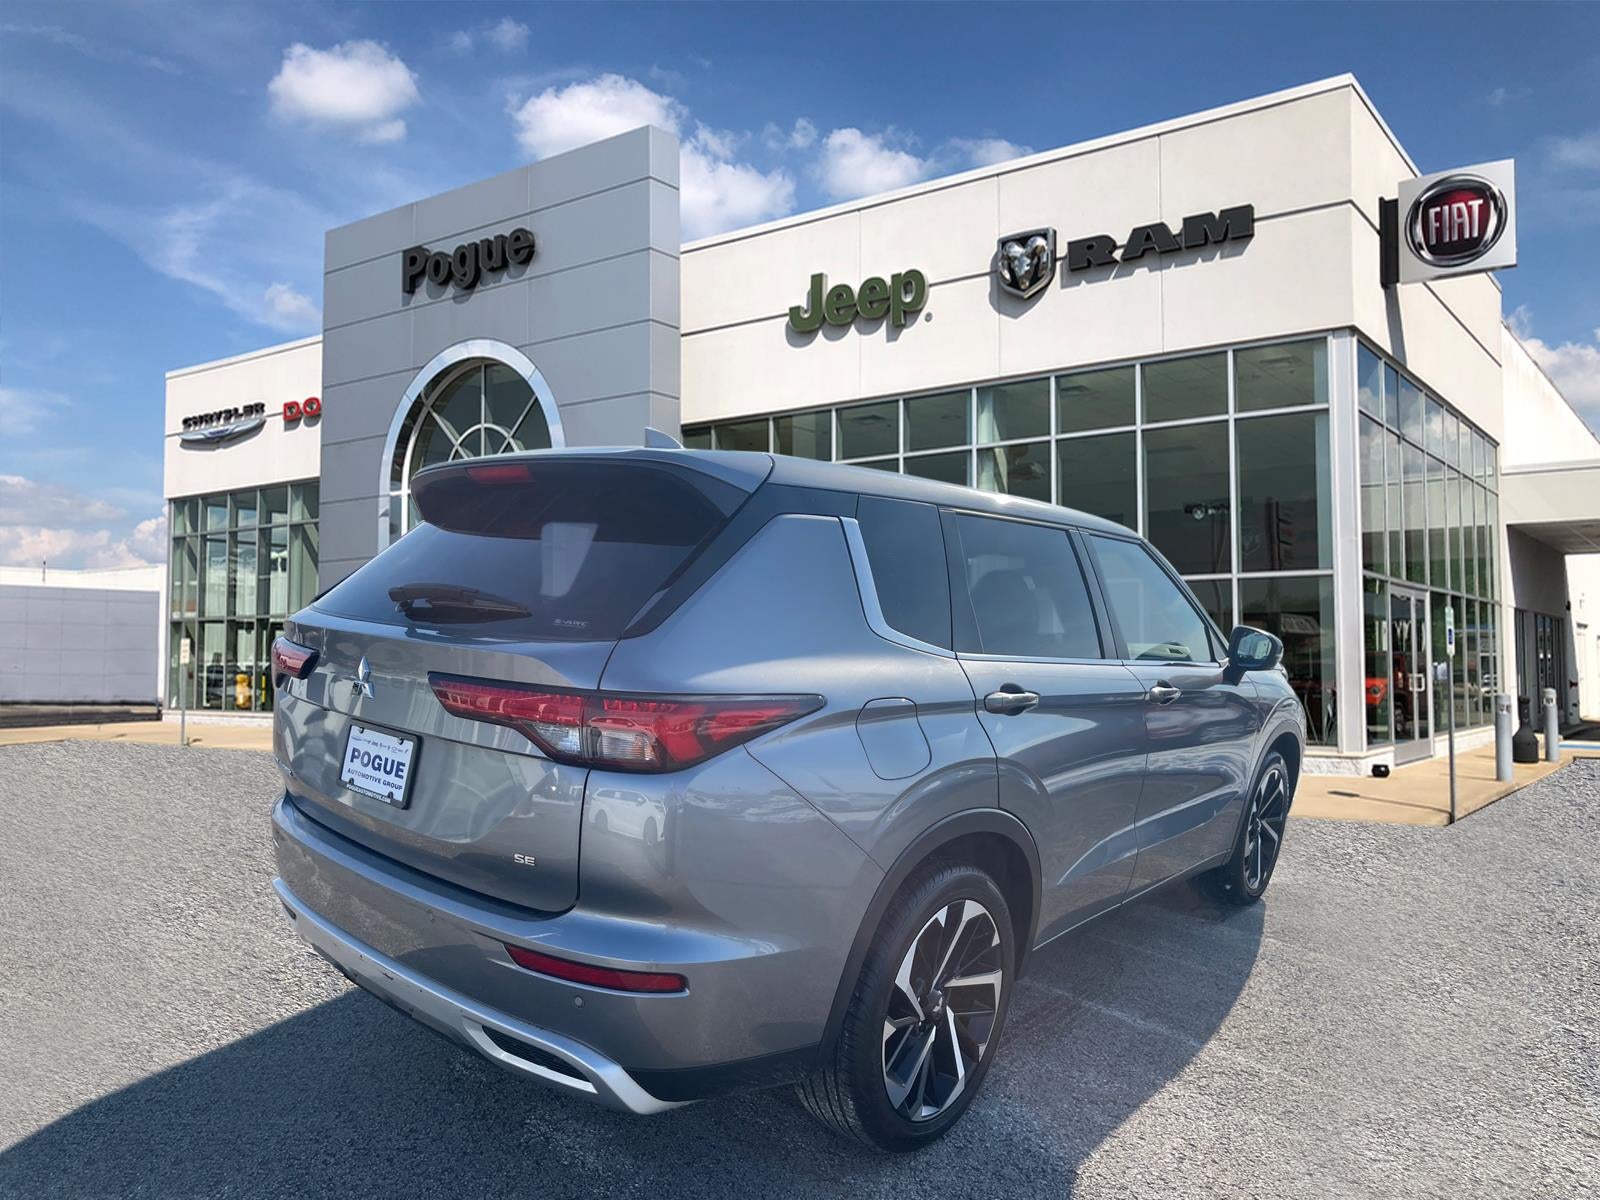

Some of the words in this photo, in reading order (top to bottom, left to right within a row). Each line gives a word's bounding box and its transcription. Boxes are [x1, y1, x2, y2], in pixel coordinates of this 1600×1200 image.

[1067, 204, 1254, 272] RAM
[1428, 199, 1483, 246] FIAT
[402, 228, 535, 294] Pogue
[789, 269, 928, 333] Jeep
[182, 402, 265, 430] CHRYSLER
[347, 768, 381, 784] AUTOMOTIVE
[383, 780, 402, 791] GROUP
[350, 747, 406, 780] POGUE
[514, 853, 535, 866] SE
